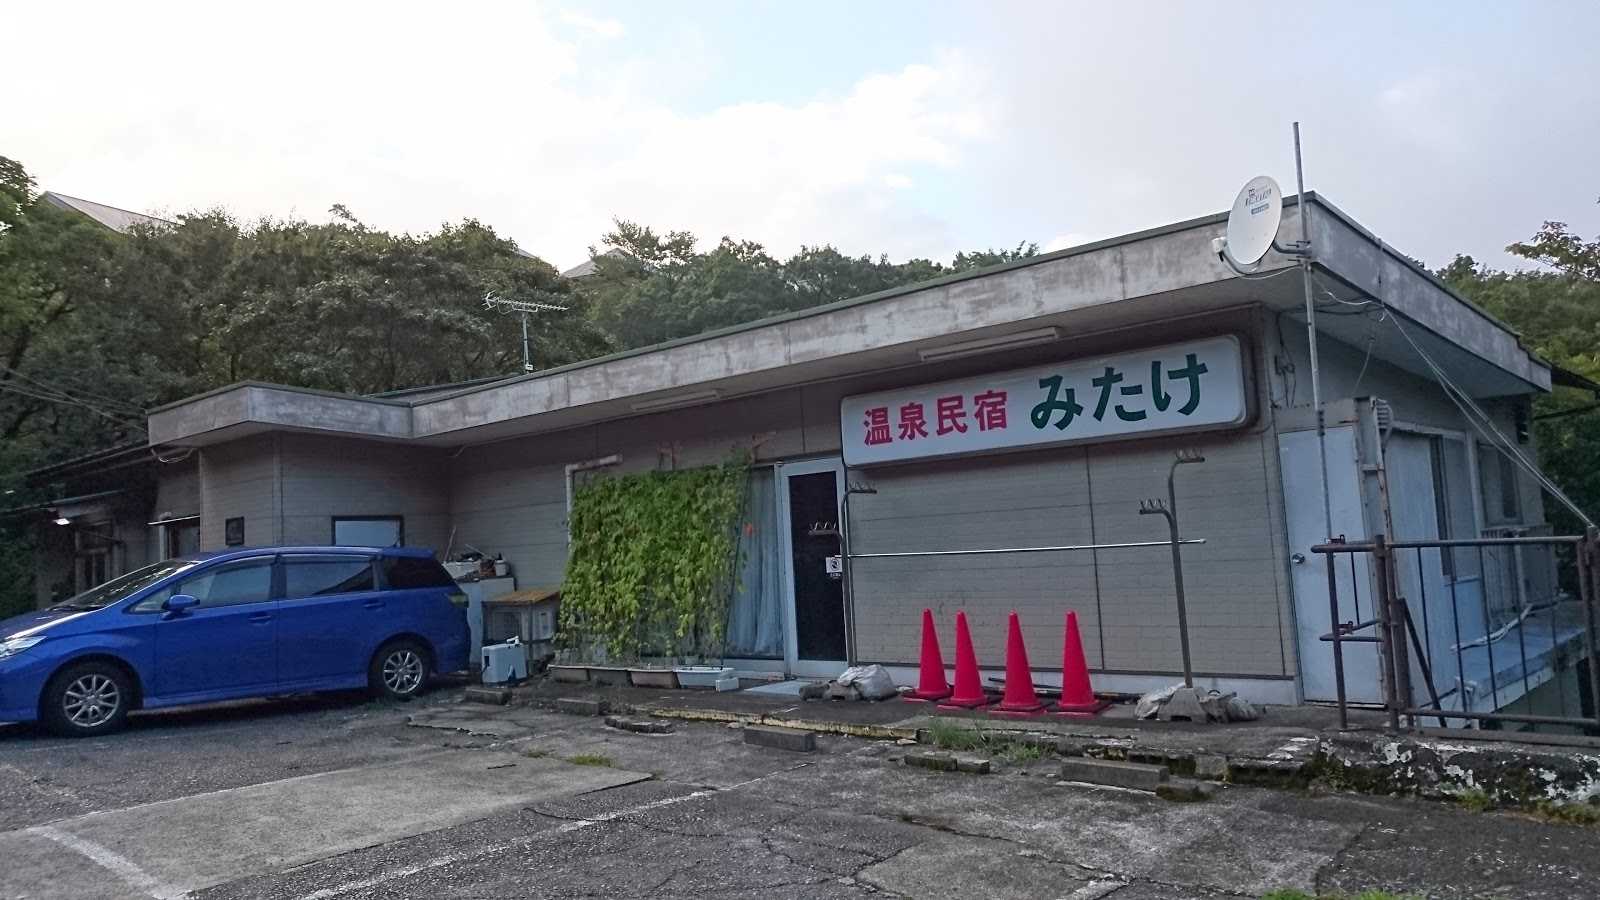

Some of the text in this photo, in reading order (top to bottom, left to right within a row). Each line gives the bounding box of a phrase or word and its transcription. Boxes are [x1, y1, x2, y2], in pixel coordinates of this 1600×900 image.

[864, 353, 1208, 447] 温泉民宿 みたけ
